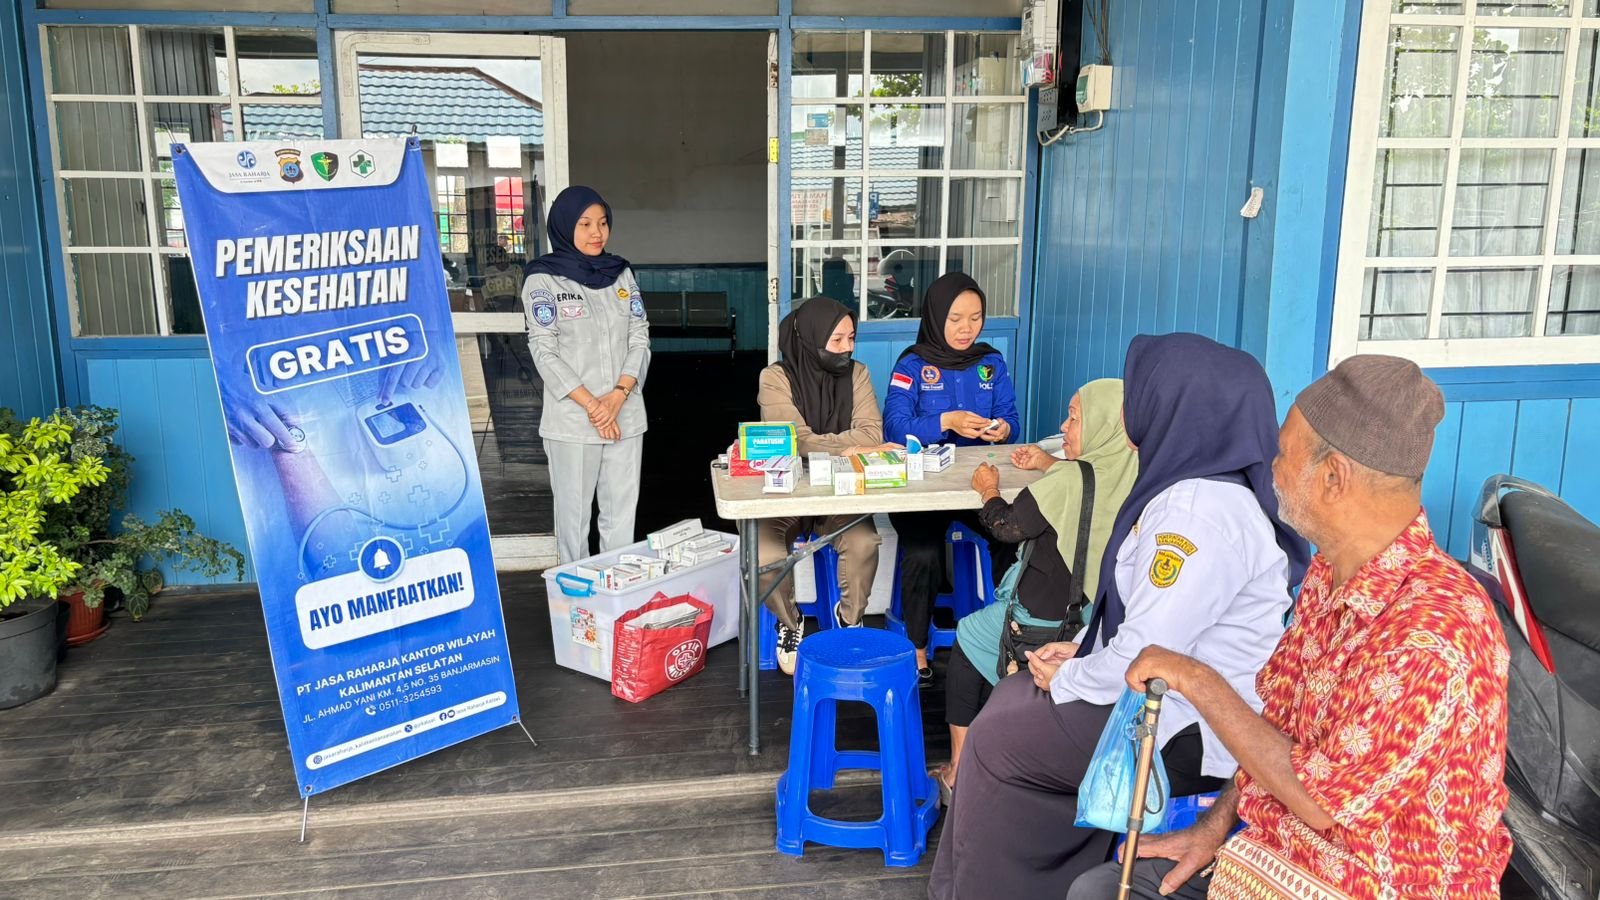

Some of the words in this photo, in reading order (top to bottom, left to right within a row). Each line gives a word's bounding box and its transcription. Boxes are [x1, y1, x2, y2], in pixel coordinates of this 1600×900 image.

[215, 225, 420, 277] PEMERIKSAAN
[246, 267, 409, 319] KESEHATAN
[556, 293, 584, 302] ERIKA
[269, 326, 410, 380] GRATIS
[309, 603, 343, 631] AYO
[347, 572, 465, 620] MANFAATKAN!
[297, 683, 311, 696] PT
[314, 673, 345, 690] JASA
[346, 657, 400, 680] RAHARJA
[401, 643, 445, 664] KANTOR
[446, 629, 496, 650] WILAYAH
[339, 668, 413, 698] KALIMANTAN
[414, 653, 463, 675] SELATAN
[303, 714, 316, 724] JL.
[318, 701, 352, 718] AHMAD
[354, 693, 376, 706] YANI
[377, 688, 394, 699] KM.
[396, 684, 409, 694] 4,5
[410, 677, 427, 688] NO.
[428, 673, 439, 683] 35
[441, 656, 500, 679] BANJARMASIN
[379, 685, 442, 711] 0511-3254593
